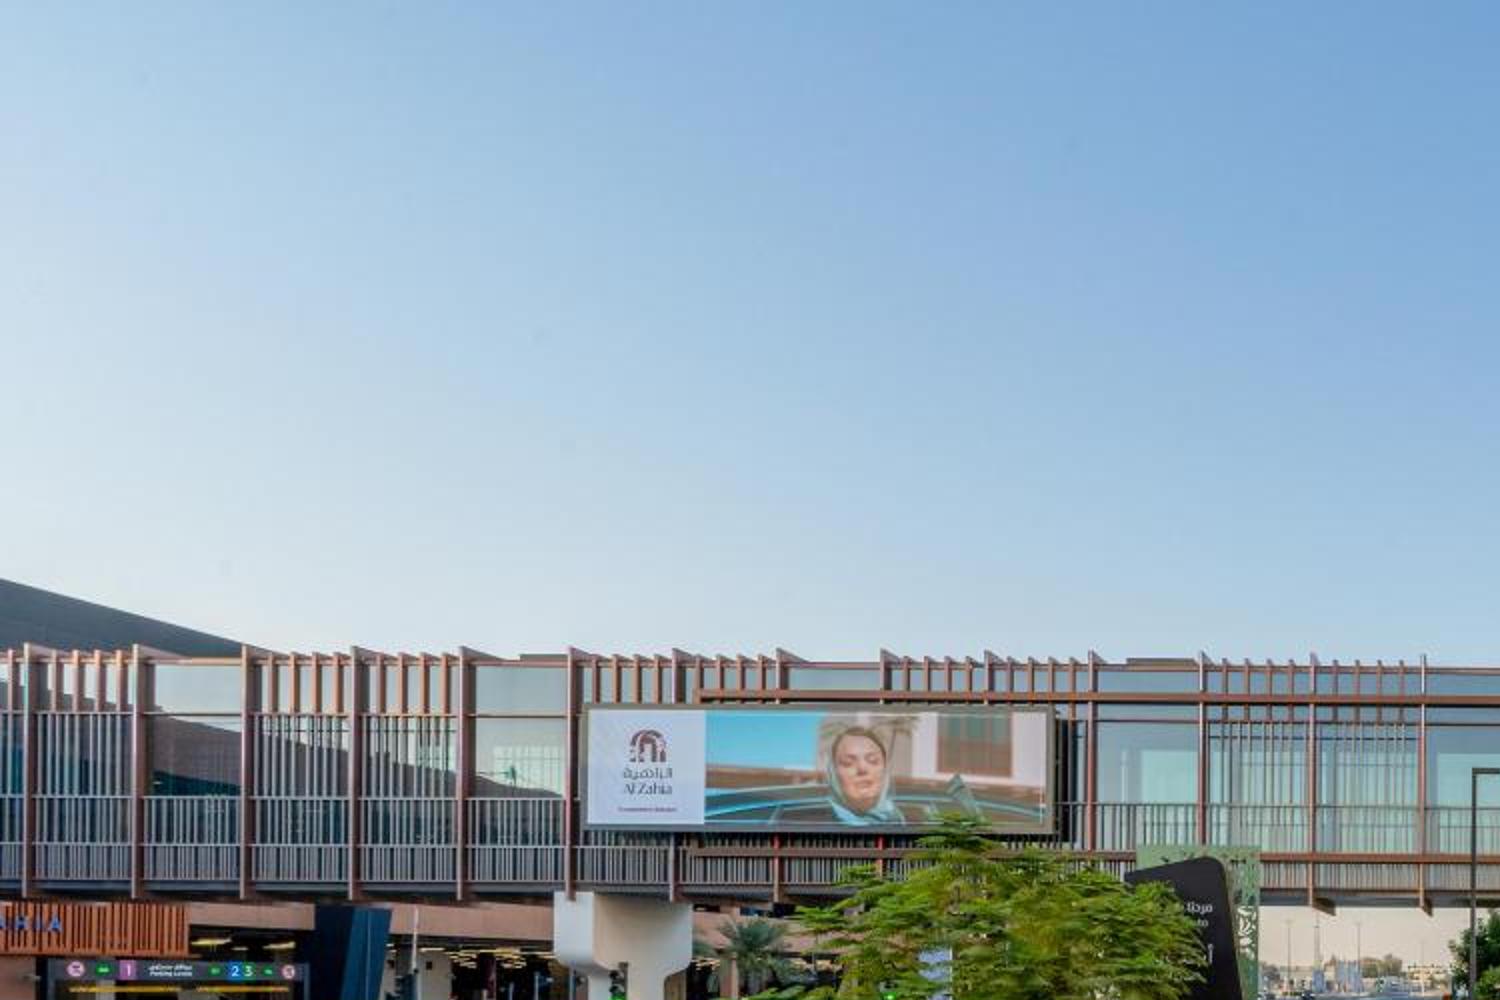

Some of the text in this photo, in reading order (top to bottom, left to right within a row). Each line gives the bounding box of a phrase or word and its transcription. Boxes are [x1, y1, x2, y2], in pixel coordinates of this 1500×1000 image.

[623, 782, 672, 795] Al Zahia
[231, 965, 240, 977] 2
[244, 965, 253, 977] 3
